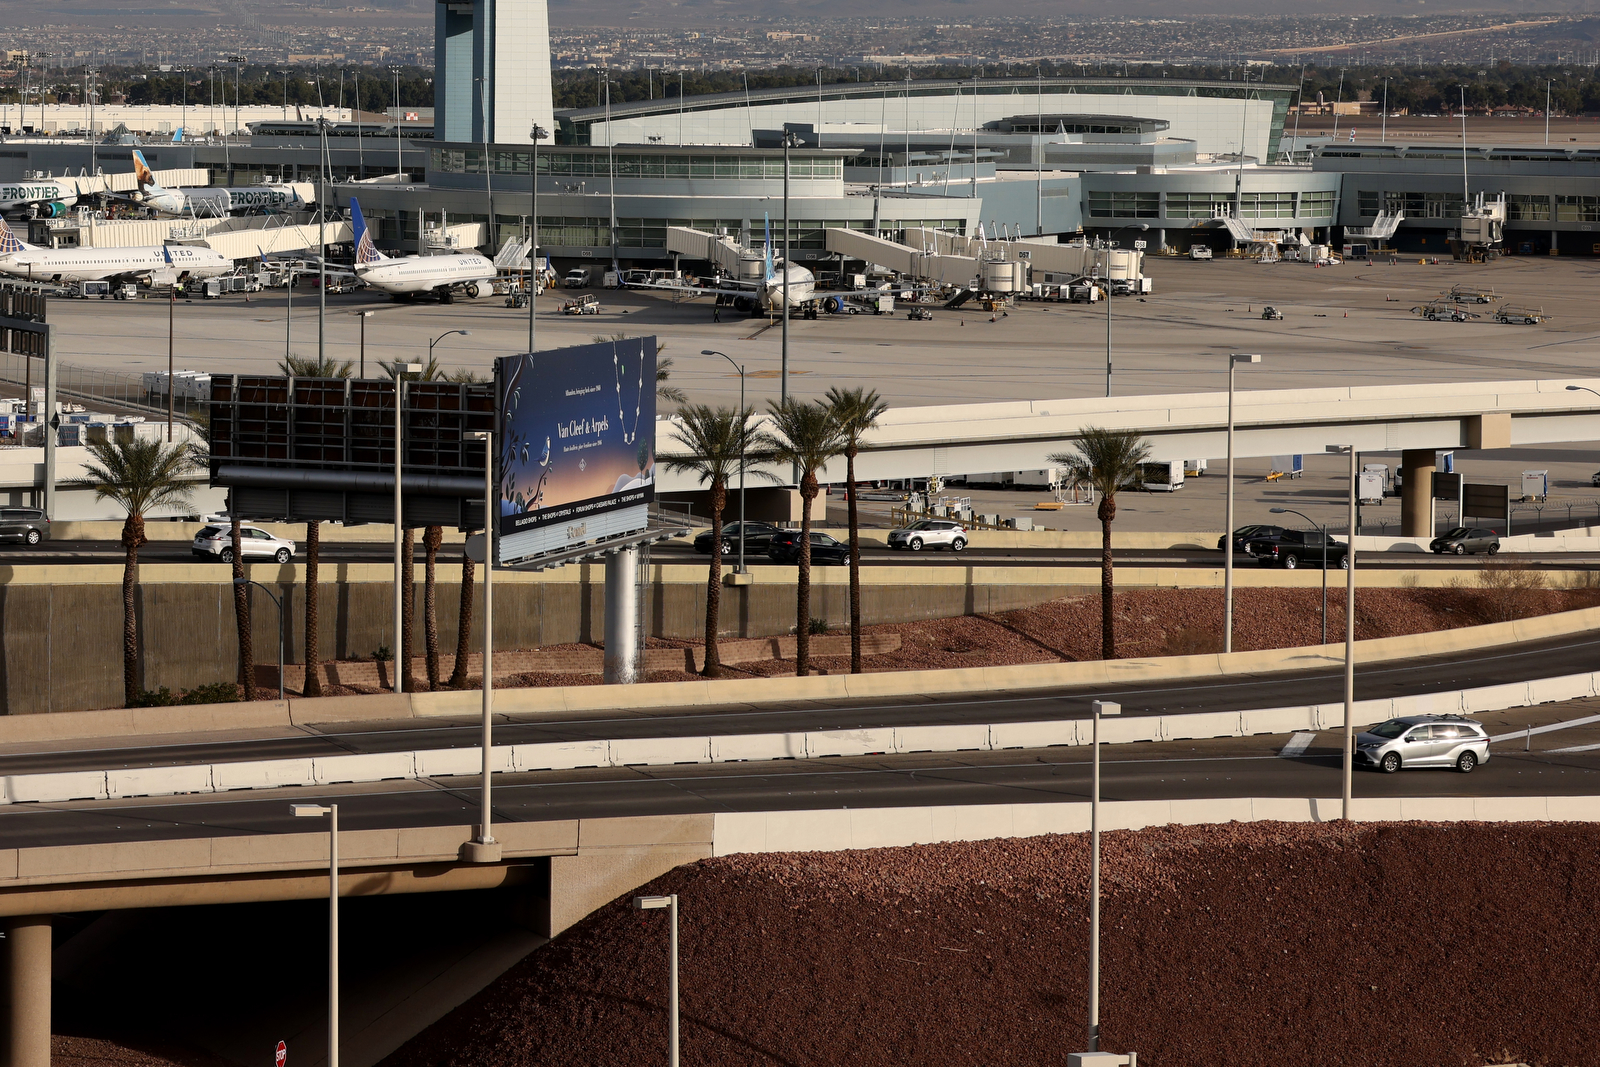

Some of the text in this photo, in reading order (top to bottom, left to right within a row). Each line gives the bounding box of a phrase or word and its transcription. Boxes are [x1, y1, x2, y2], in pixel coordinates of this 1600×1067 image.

[2, 187, 59, 199] FRONTIER
[230, 192, 286, 204] FRONTIER
[558, 415, 608, 438] Van Cleef & Arpels
[276, 1049, 286, 1061] STOP
